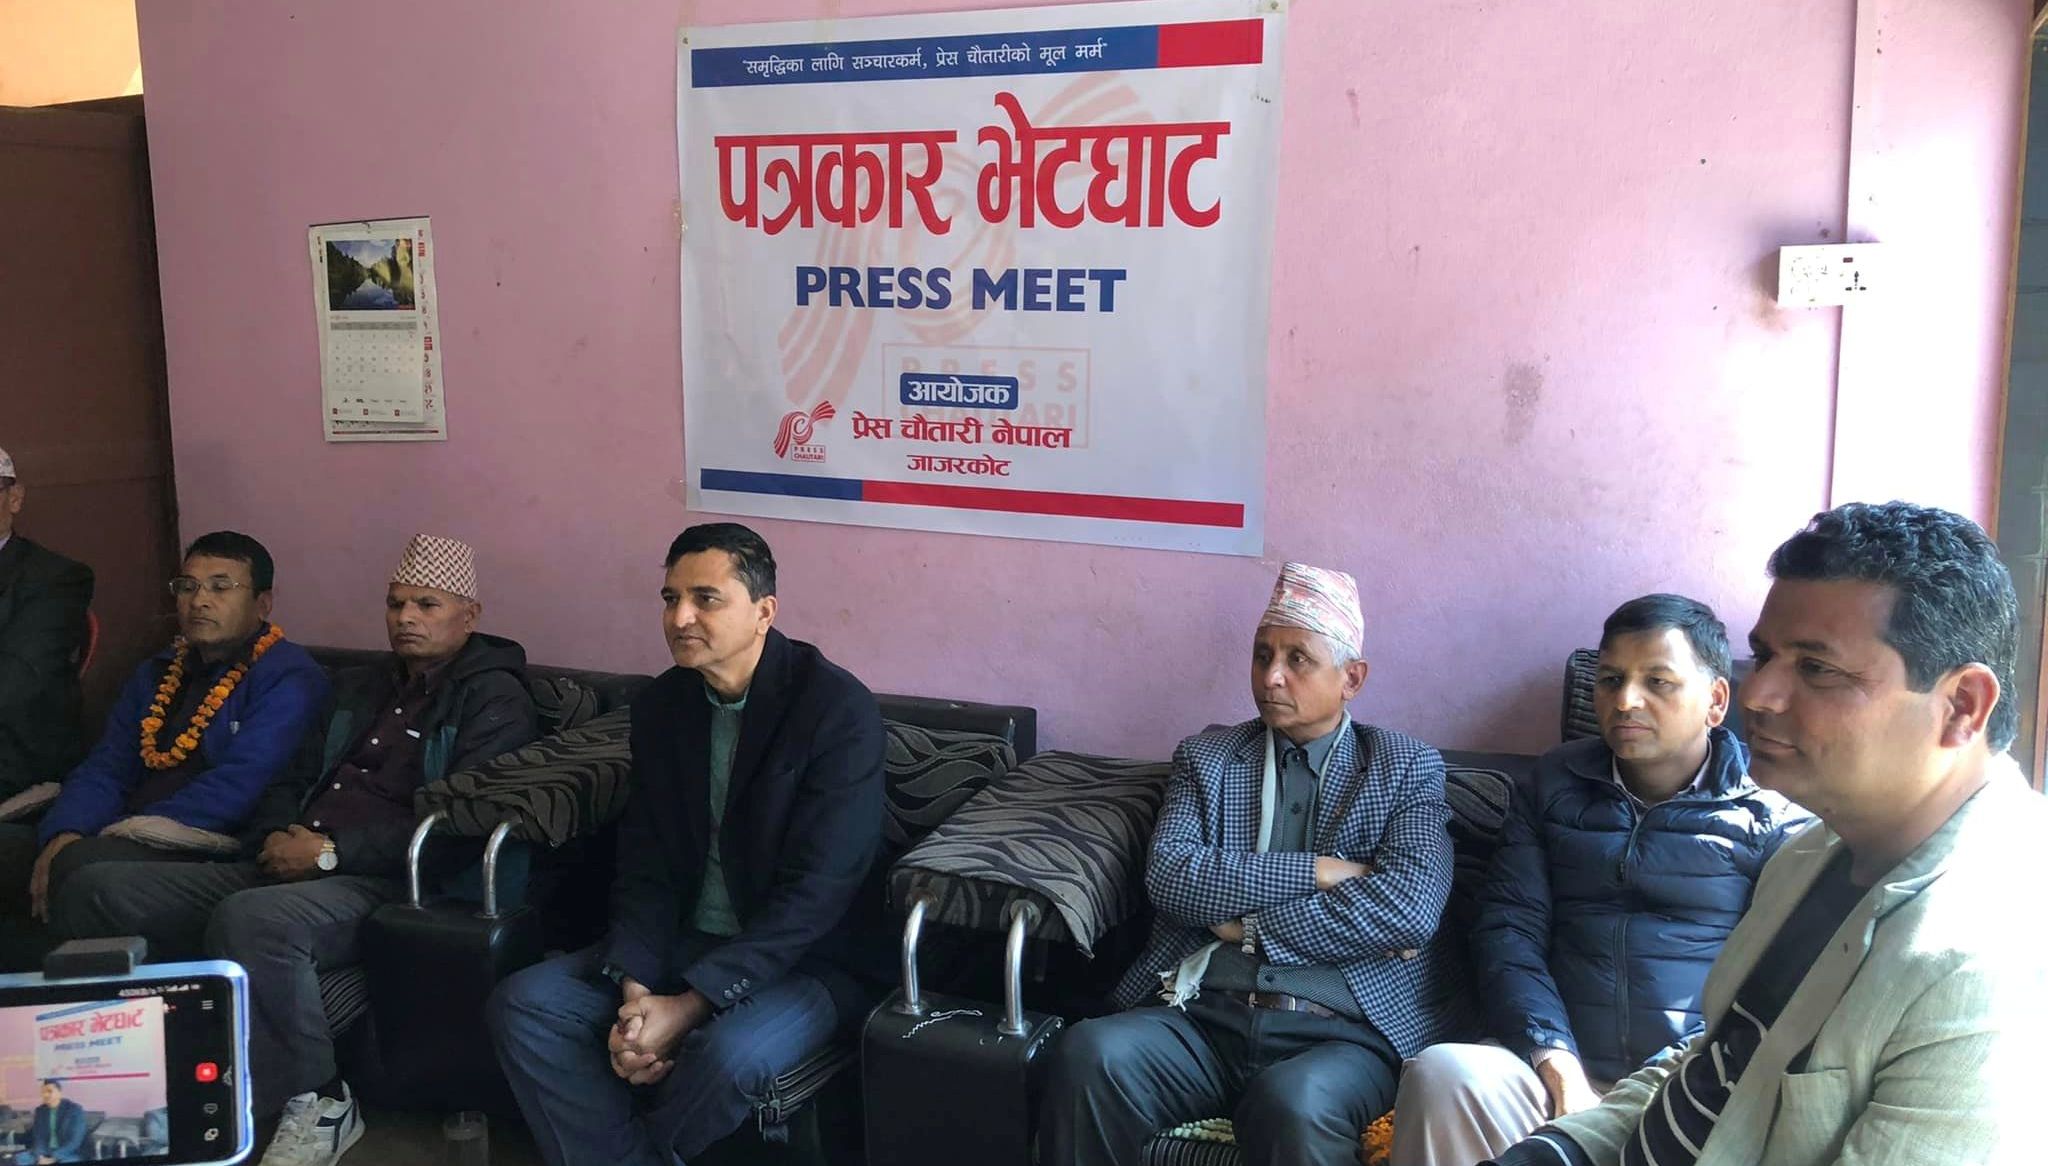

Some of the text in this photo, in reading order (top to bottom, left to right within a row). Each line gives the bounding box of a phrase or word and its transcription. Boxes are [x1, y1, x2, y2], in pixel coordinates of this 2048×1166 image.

[811, 52, 844, 72] लागि
[936, 46, 959, 67] प्रेस
[966, 42, 1031, 64] चौतारीको
[1039, 45, 1067, 67] मूल
[714, 91, 1232, 236] पत्रकार भेटघाट
[796, 266, 1127, 313] PRESS MEET
[908, 376, 1011, 405] आयोजक
[852, 410, 893, 440] प्रेस
[900, 413, 983, 445] चौतारी
[991, 418, 1073, 449] नेपाल
[907, 453, 1012, 476] जाजरकोट
